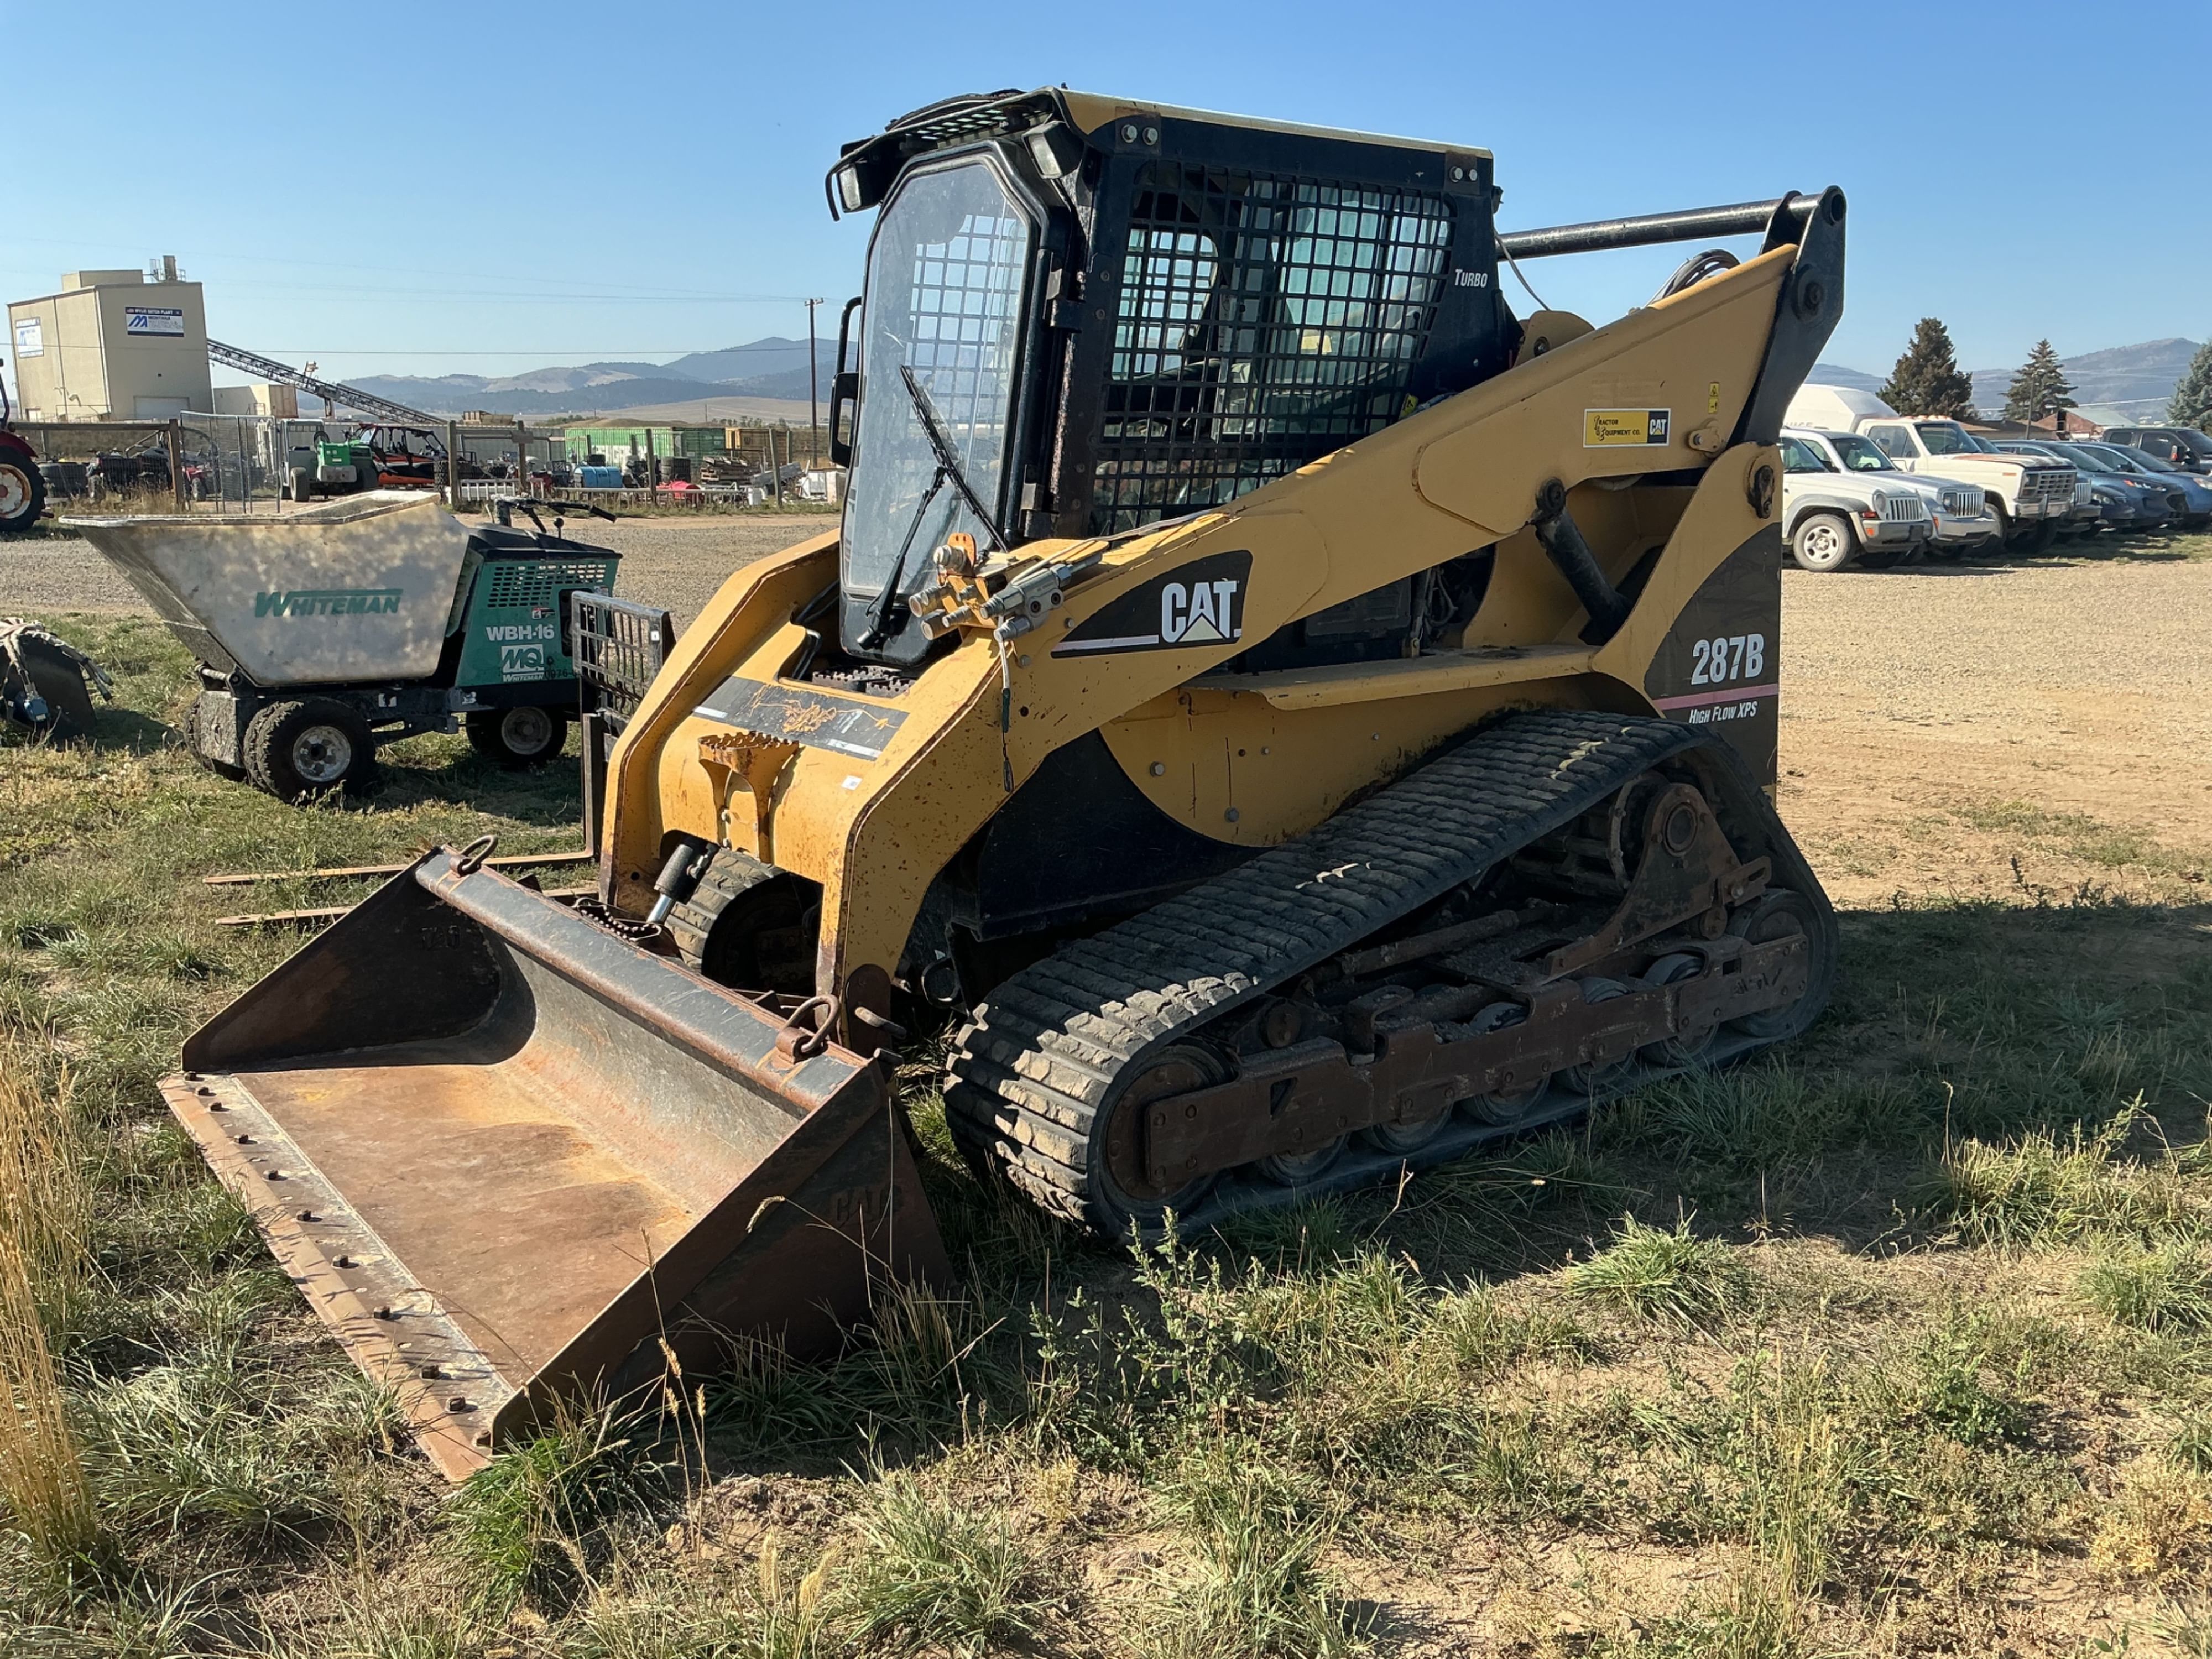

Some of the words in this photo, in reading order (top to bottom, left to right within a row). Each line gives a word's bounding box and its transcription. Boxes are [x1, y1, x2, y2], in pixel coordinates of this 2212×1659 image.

[1455, 269, 1488, 288] TURBO
[1594, 415, 1619, 430] TRACTOR
[1650, 419, 1667, 435] CAT
[1598, 427, 1631, 441] EQUIPMENT
[255, 589, 403, 618] WHITEMAN
[1162, 581, 1237, 643] CAT
[1691, 633, 1764, 685] 287B
[503, 672, 544, 682] WHITEMAN
[1689, 709, 1711, 724] HIGH
[1712, 706, 1737, 721] FLOW
[1737, 701, 1758, 718] XPS
